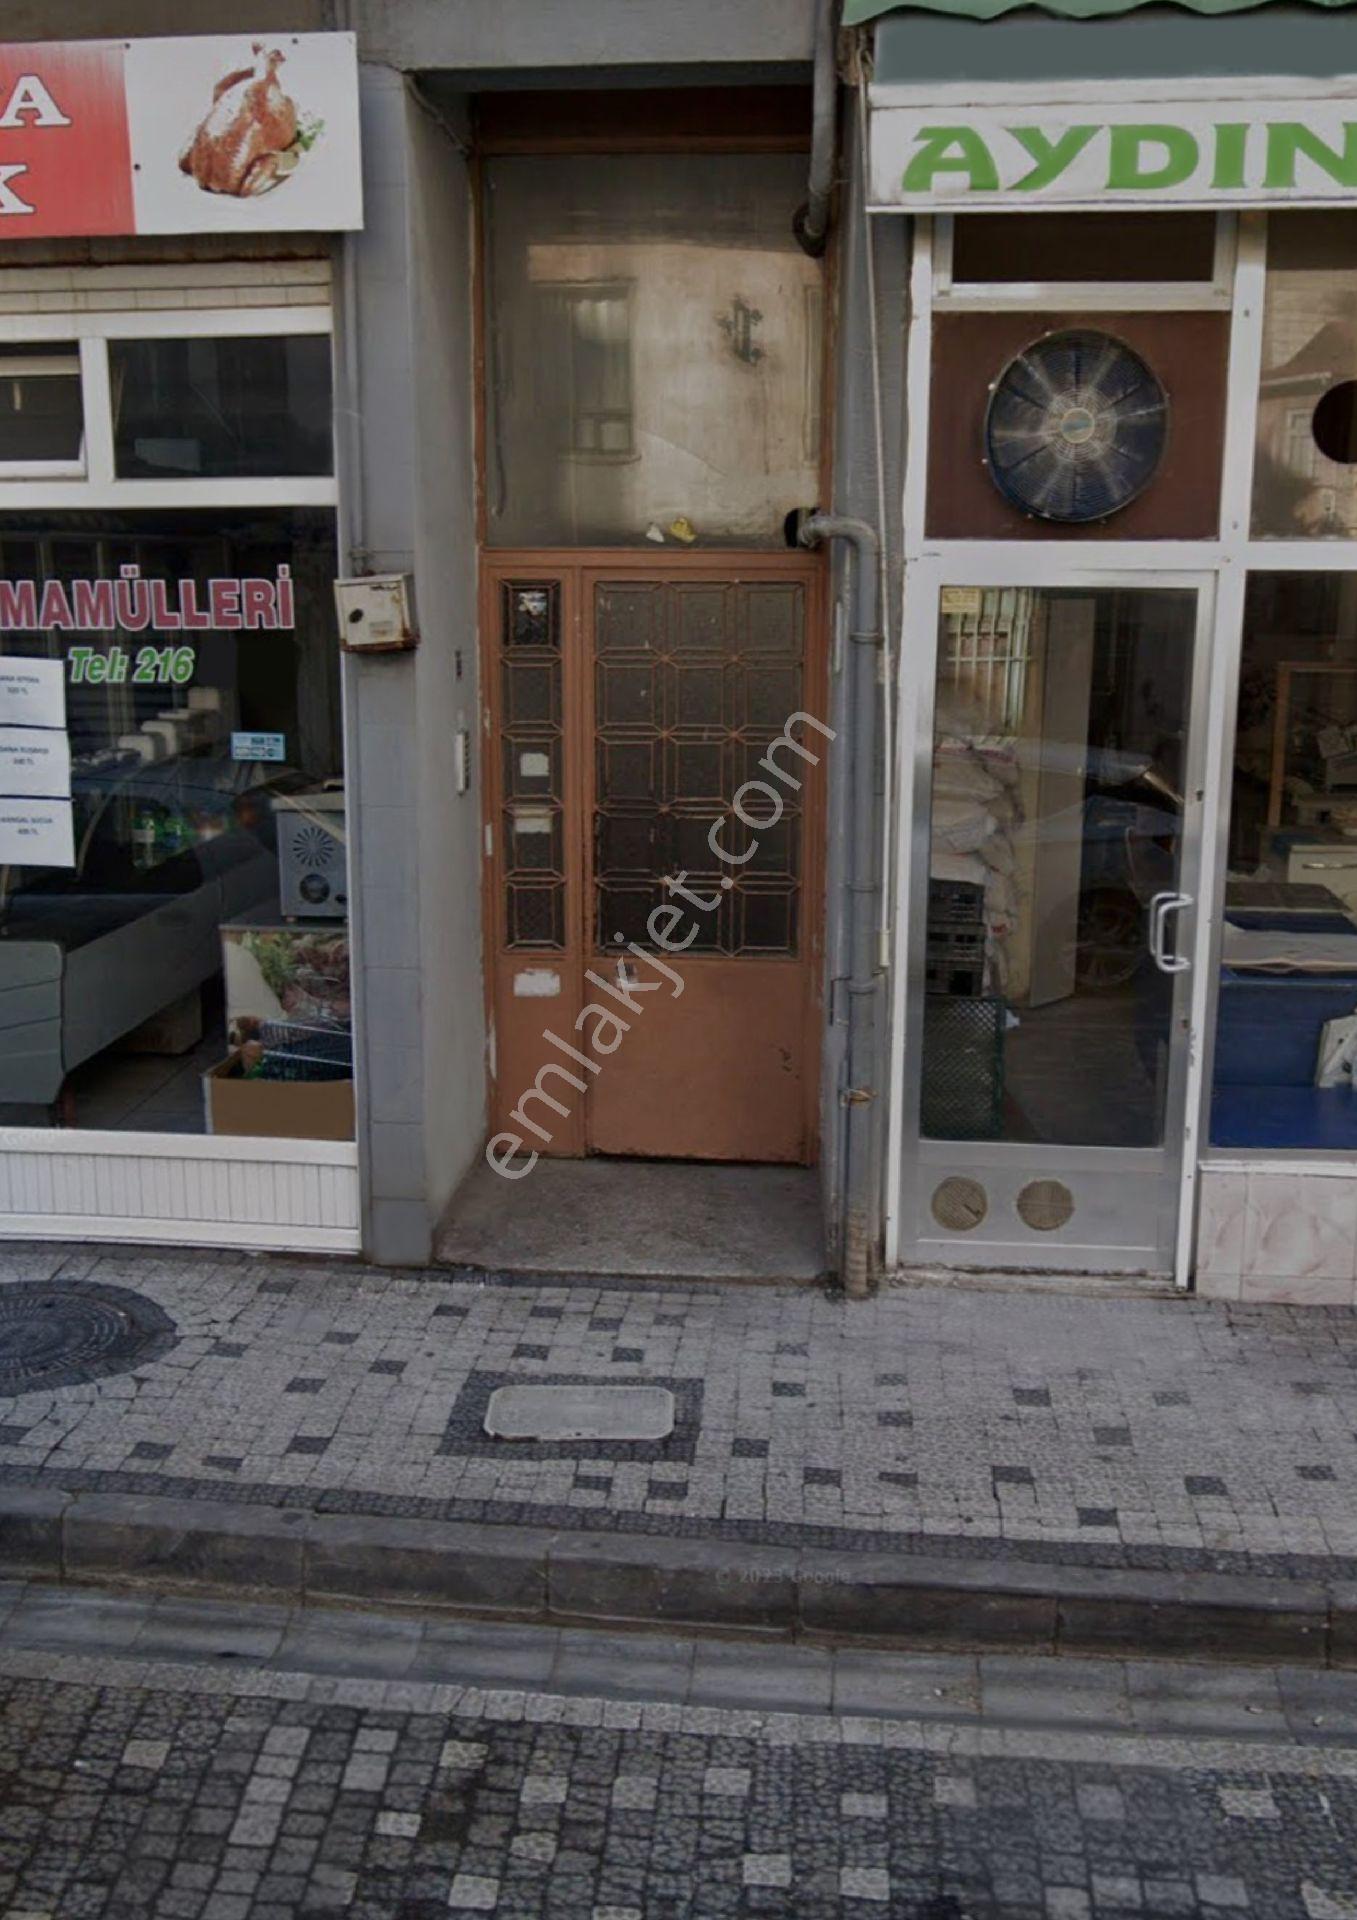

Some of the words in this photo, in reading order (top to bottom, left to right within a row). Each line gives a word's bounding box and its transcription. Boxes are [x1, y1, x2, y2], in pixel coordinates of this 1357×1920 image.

[902, 122, 1357, 192] AYDIN
[0, 563, 295, 631] MAMÜLLERİ
[132, 646, 196, 683] 216
